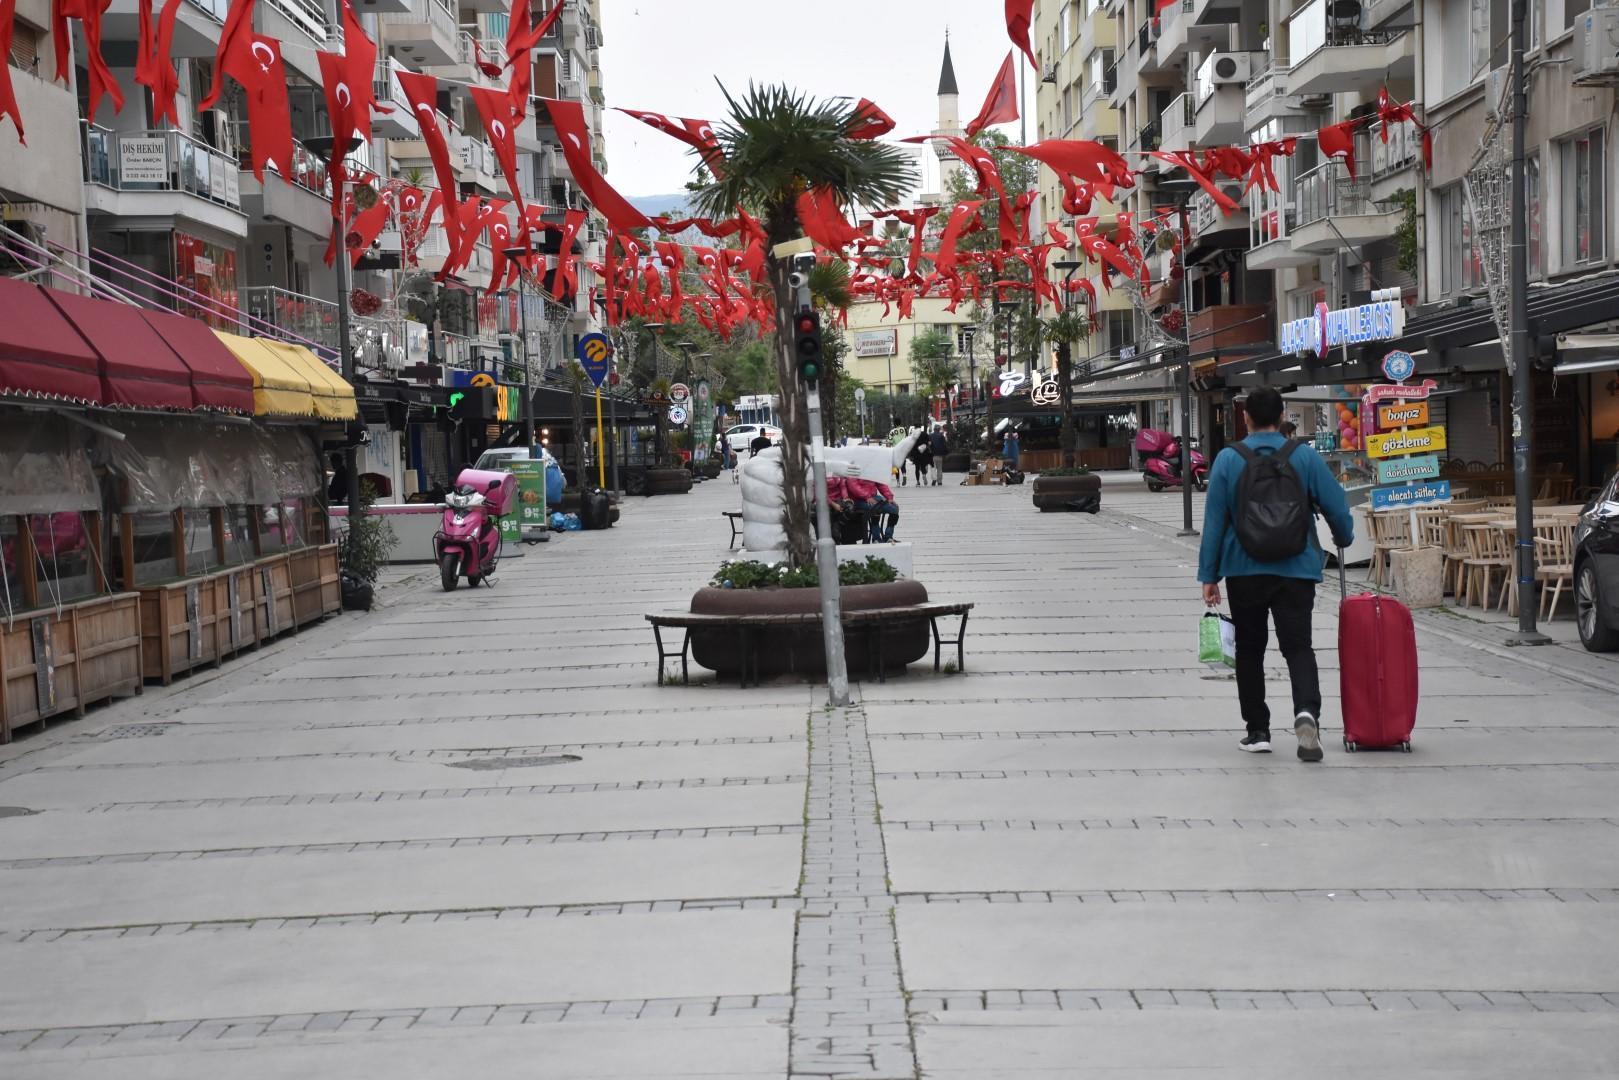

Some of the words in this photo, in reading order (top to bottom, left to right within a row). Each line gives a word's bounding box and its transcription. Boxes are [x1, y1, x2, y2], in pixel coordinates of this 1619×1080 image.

[122, 142, 135, 155] DİŞ
[136, 142, 164, 154] HEKİMİ
[1281, 319, 1310, 357] ALAÇAT
[1387, 409, 1420, 423] boyoz
[1382, 433, 1431, 454] gözleme
[1386, 464, 1433, 478] dondurma
[1388, 489, 1413, 503] alaçatı
[1414, 485, 1437, 499] sütlaç
[524, 507, 532, 518] 9
[502, 520, 510, 532] 9
